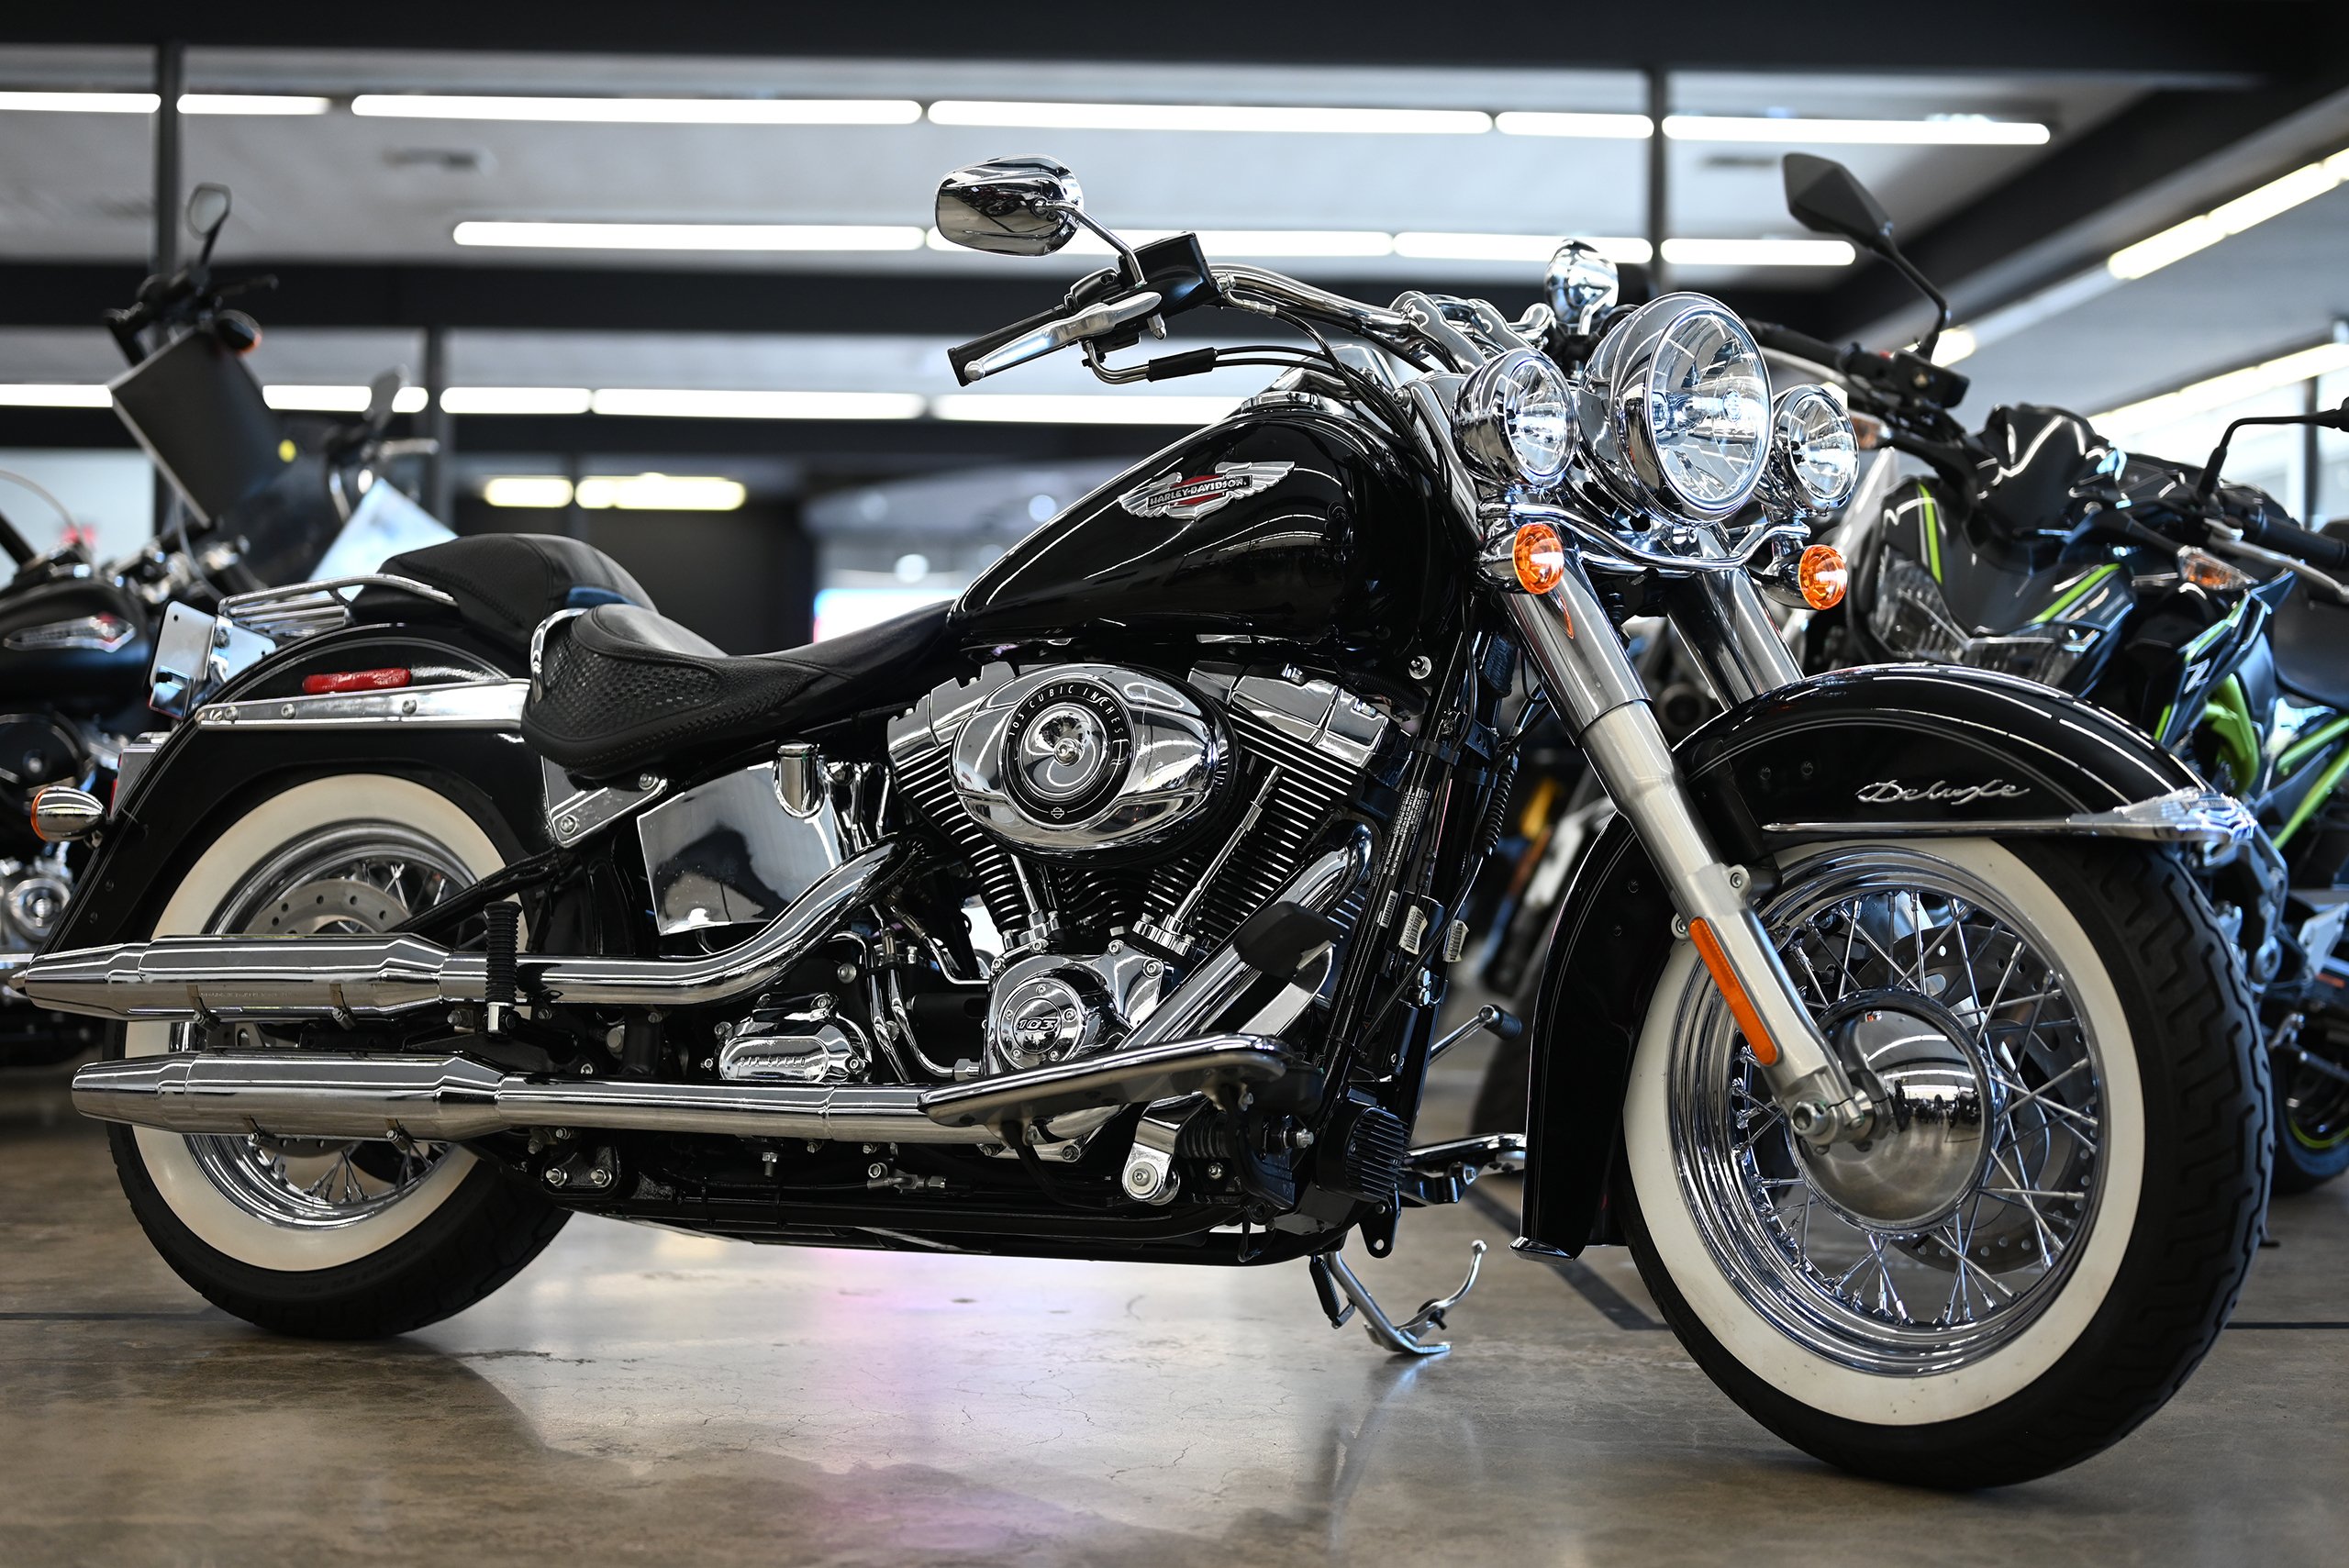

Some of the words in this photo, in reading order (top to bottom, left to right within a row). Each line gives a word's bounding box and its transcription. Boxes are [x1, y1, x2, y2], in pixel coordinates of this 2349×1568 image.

[1009, 712, 1025, 736] 103
[1029, 684, 1074, 708] CUBIC
[1082, 687, 1124, 734] INCHES
[1854, 779, 2032, 805] Deluxe
[1017, 1018, 1059, 1032] 103
[740, 1056, 760, 1068] SIX
[767, 1056, 807, 1068] SPEED
